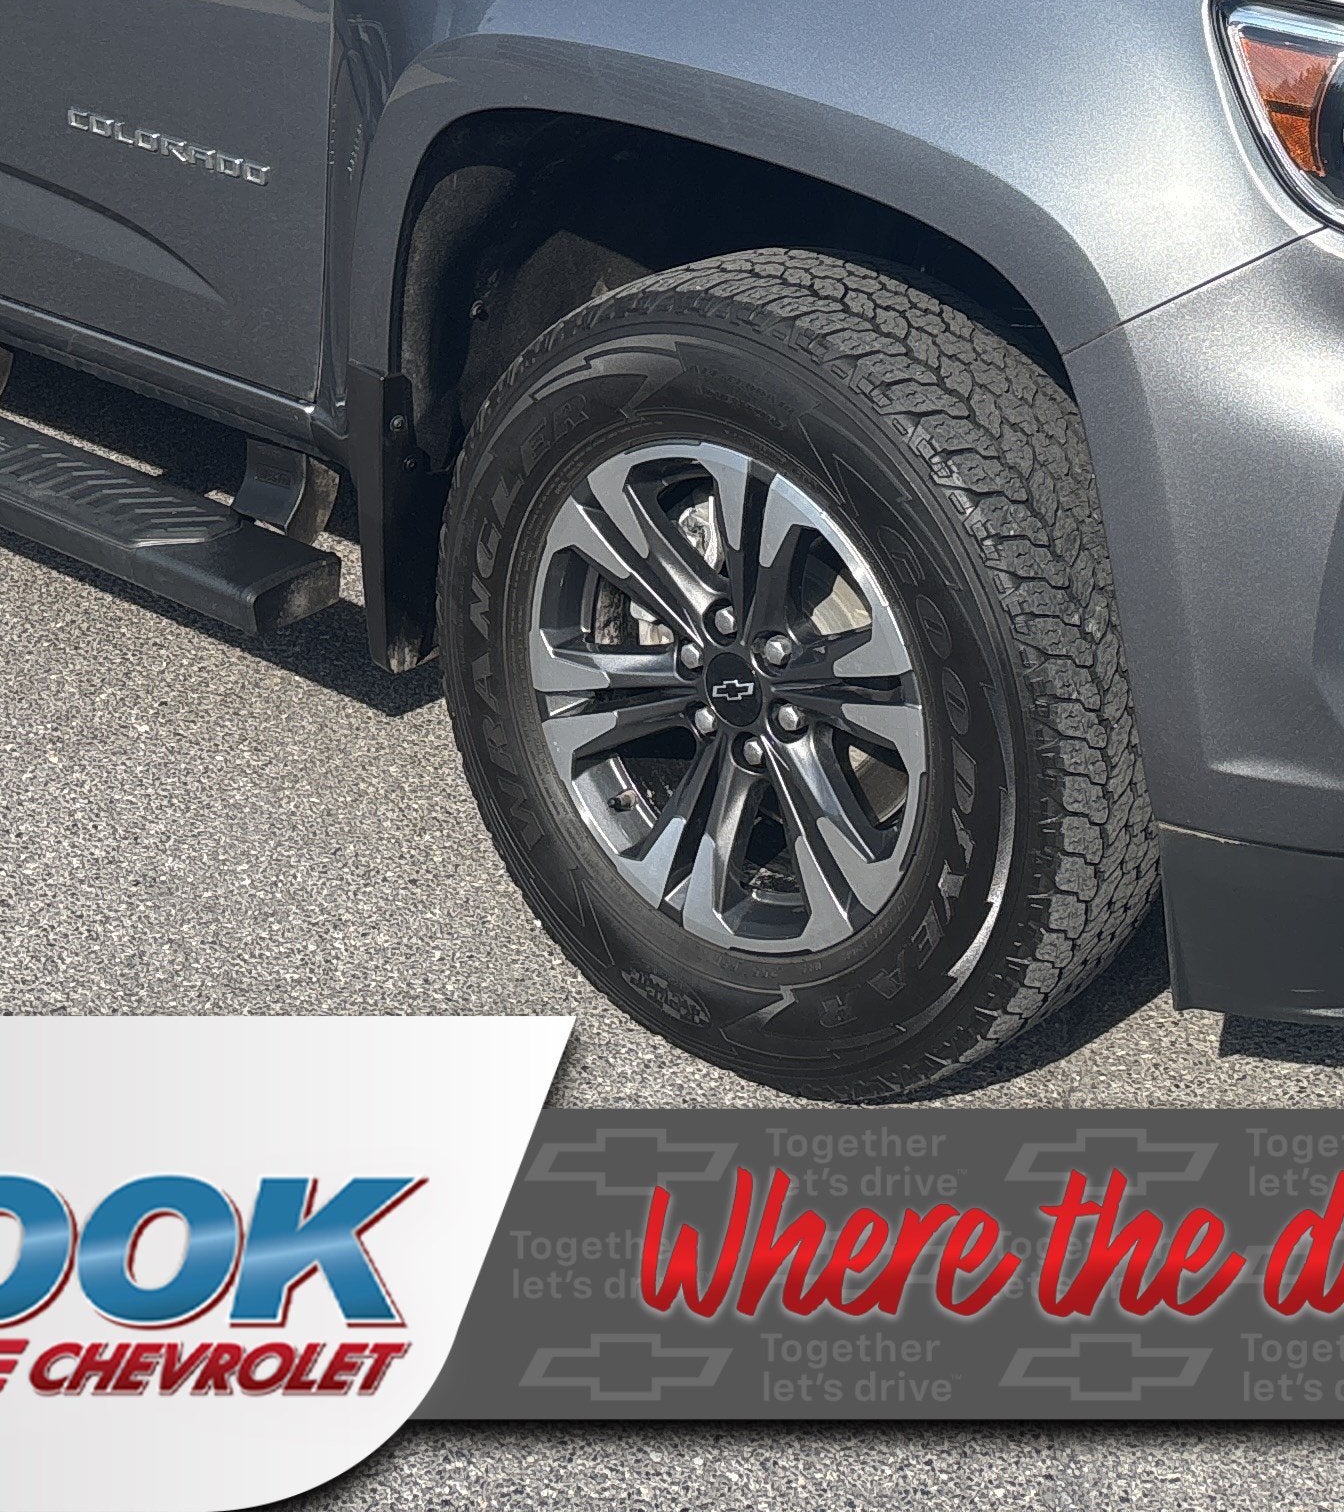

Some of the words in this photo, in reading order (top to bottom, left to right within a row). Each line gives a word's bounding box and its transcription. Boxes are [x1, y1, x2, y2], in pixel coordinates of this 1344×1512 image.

[67, 107, 270, 185] COLORADO
[469, 391, 592, 853] WRANGLER
[818, 523, 978, 1032] GOODYEAR
